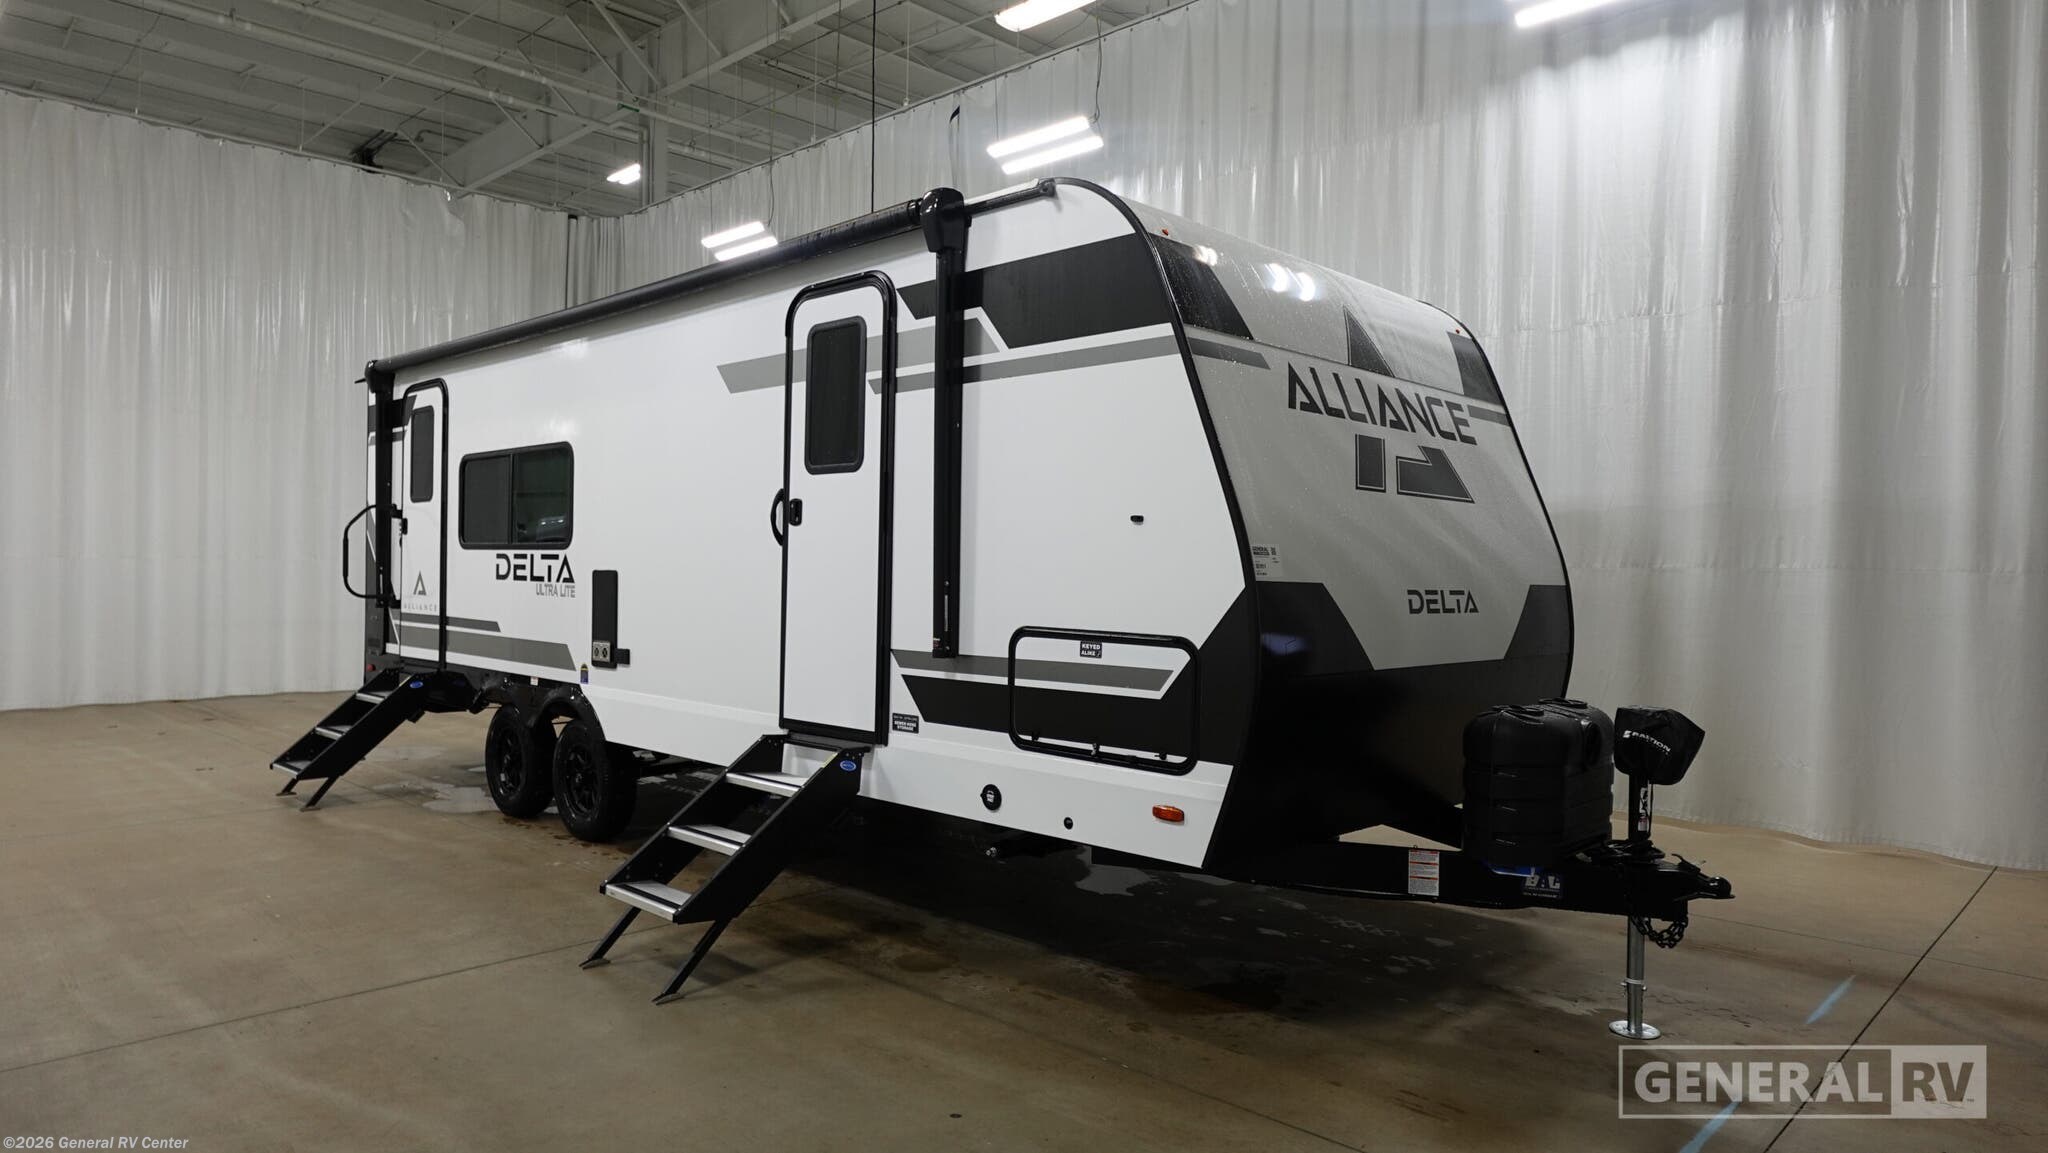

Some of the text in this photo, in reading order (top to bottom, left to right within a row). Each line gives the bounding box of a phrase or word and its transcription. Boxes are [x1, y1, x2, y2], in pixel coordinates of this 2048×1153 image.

[1287, 361, 1478, 446] ALLIANCE
[495, 553, 575, 584] DELTA
[535, 583, 576, 599] ULTRA LITE
[1406, 589, 1479, 615] DELTA
